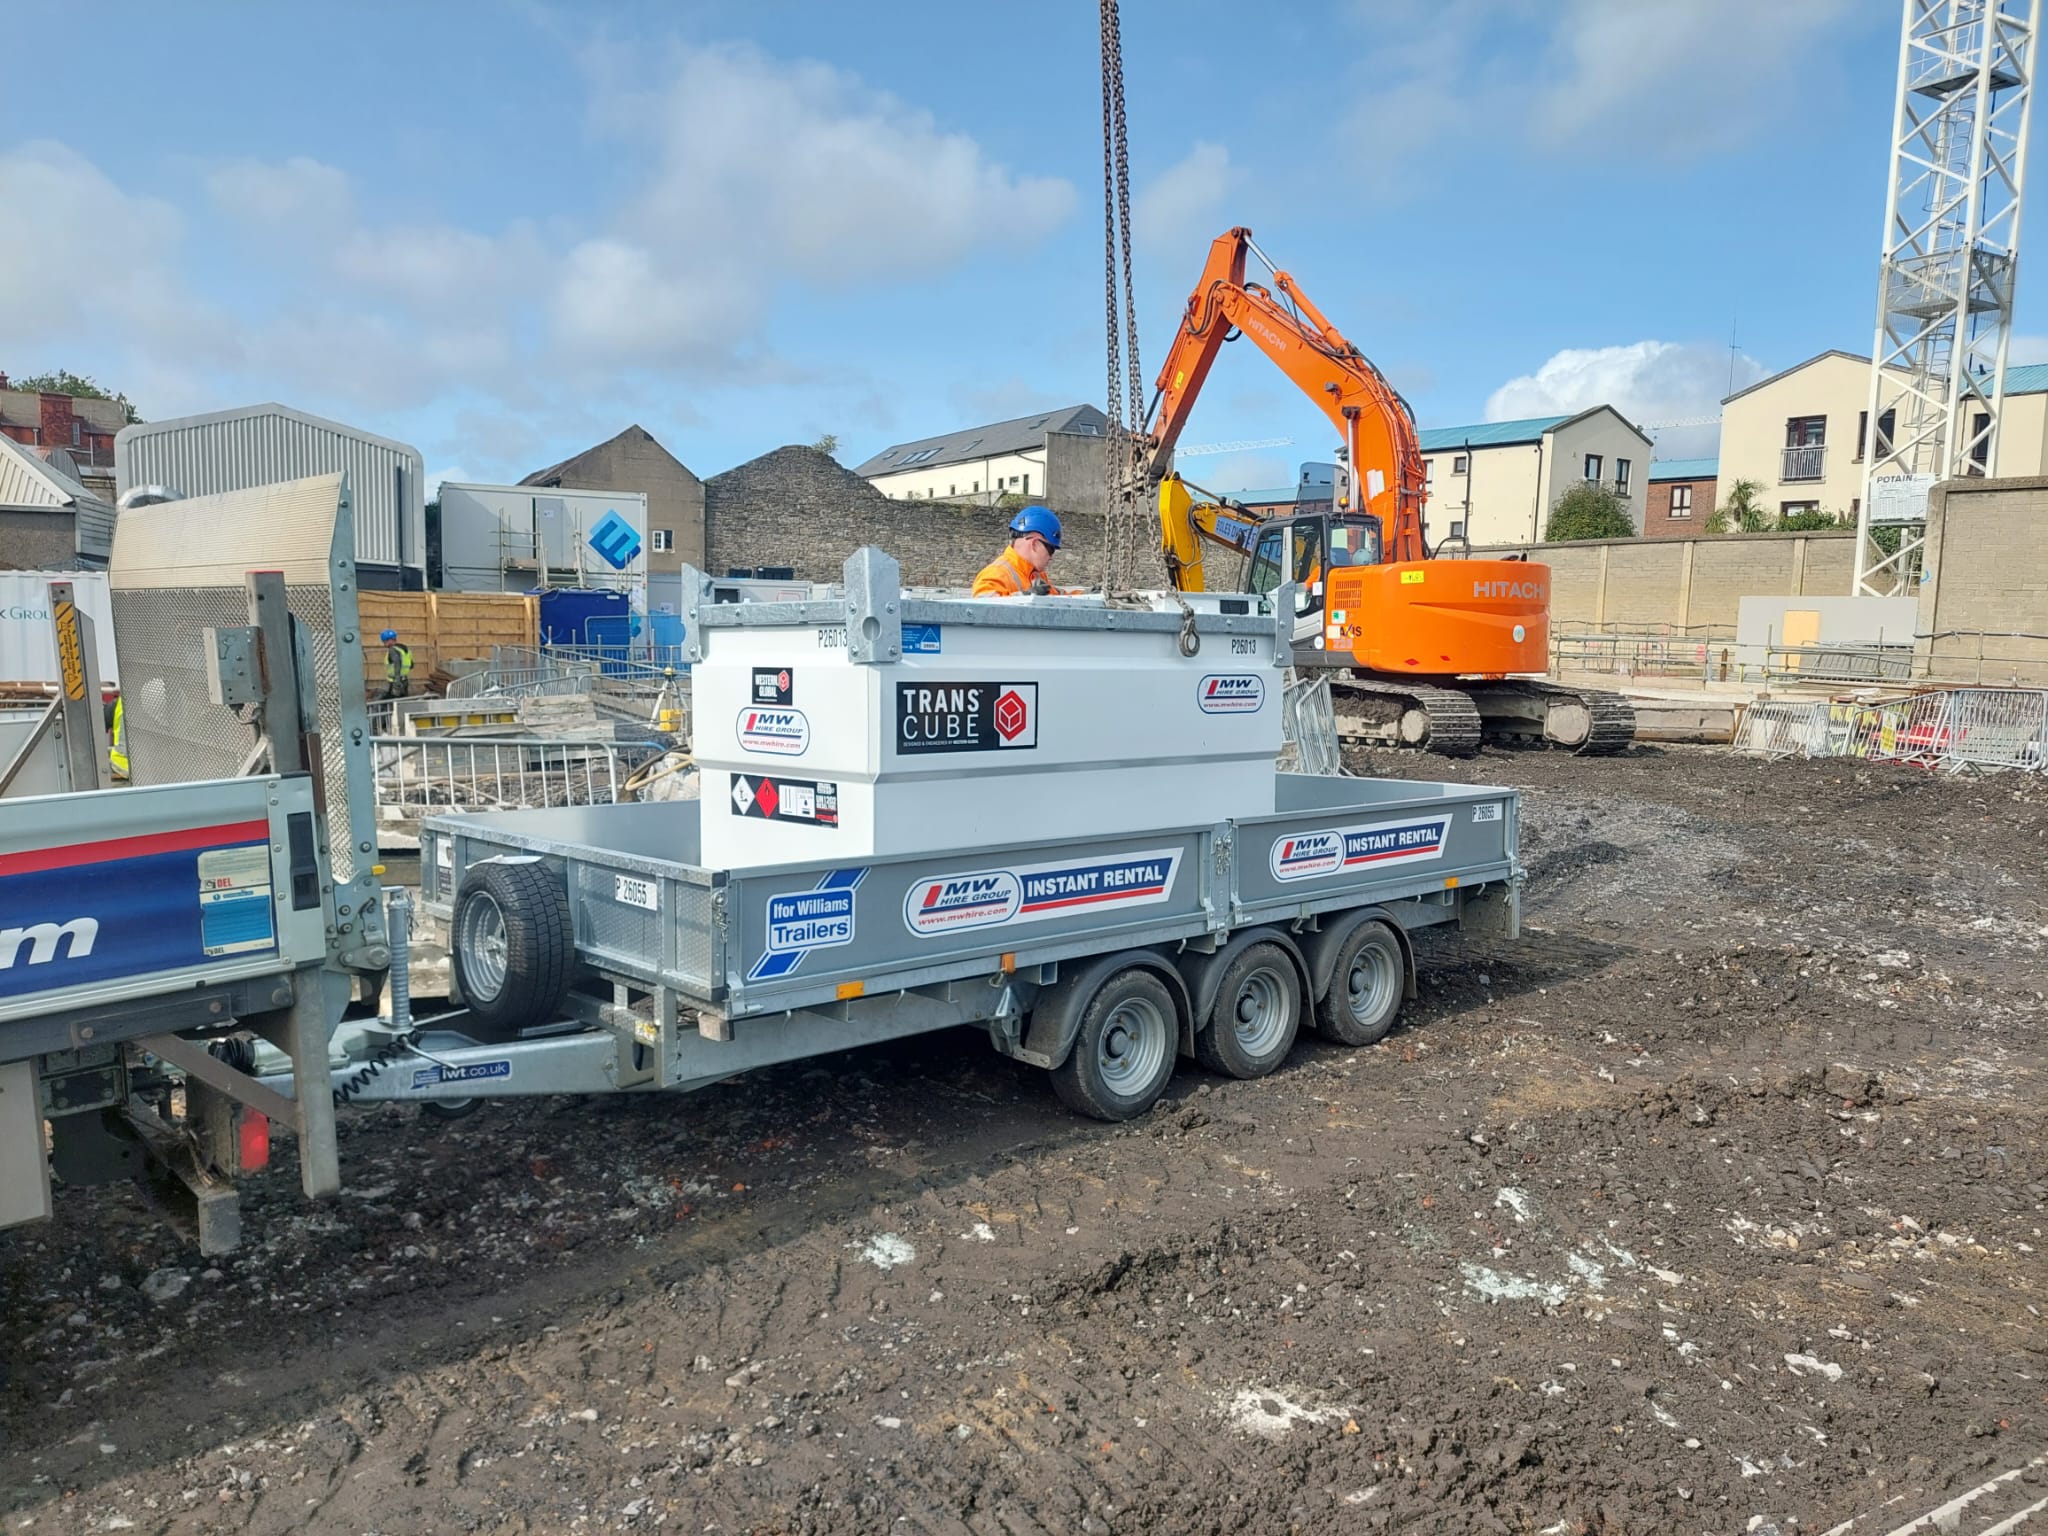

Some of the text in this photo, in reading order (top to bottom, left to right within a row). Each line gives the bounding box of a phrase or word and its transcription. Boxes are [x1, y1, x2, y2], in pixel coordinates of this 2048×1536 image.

[1876, 474, 1913, 483] POTAIN
[818, 629, 848, 648] P26013
[1231, 639, 1257, 654] P26013
[1220, 680, 1252, 688] MW
[757, 713, 794, 725] MW
[903, 714, 980, 739] CUBE
[1296, 828, 1439, 853] MW INSTANT RENTAL
[1292, 846, 1339, 857] HIRE GROUP
[216, 878, 232, 888] DEL
[944, 864, 1163, 898] MW INSTANT RENTAL
[623, 879, 647, 905] 26055
[940, 889, 1012, 906] HIRE GROUP
[773, 898, 849, 919] Ifor Williams
[919, 907, 1008, 926] www.mwhire.com
[774, 921, 848, 944] Trailers
[441, 1064, 506, 1080] iwt.co.uk
